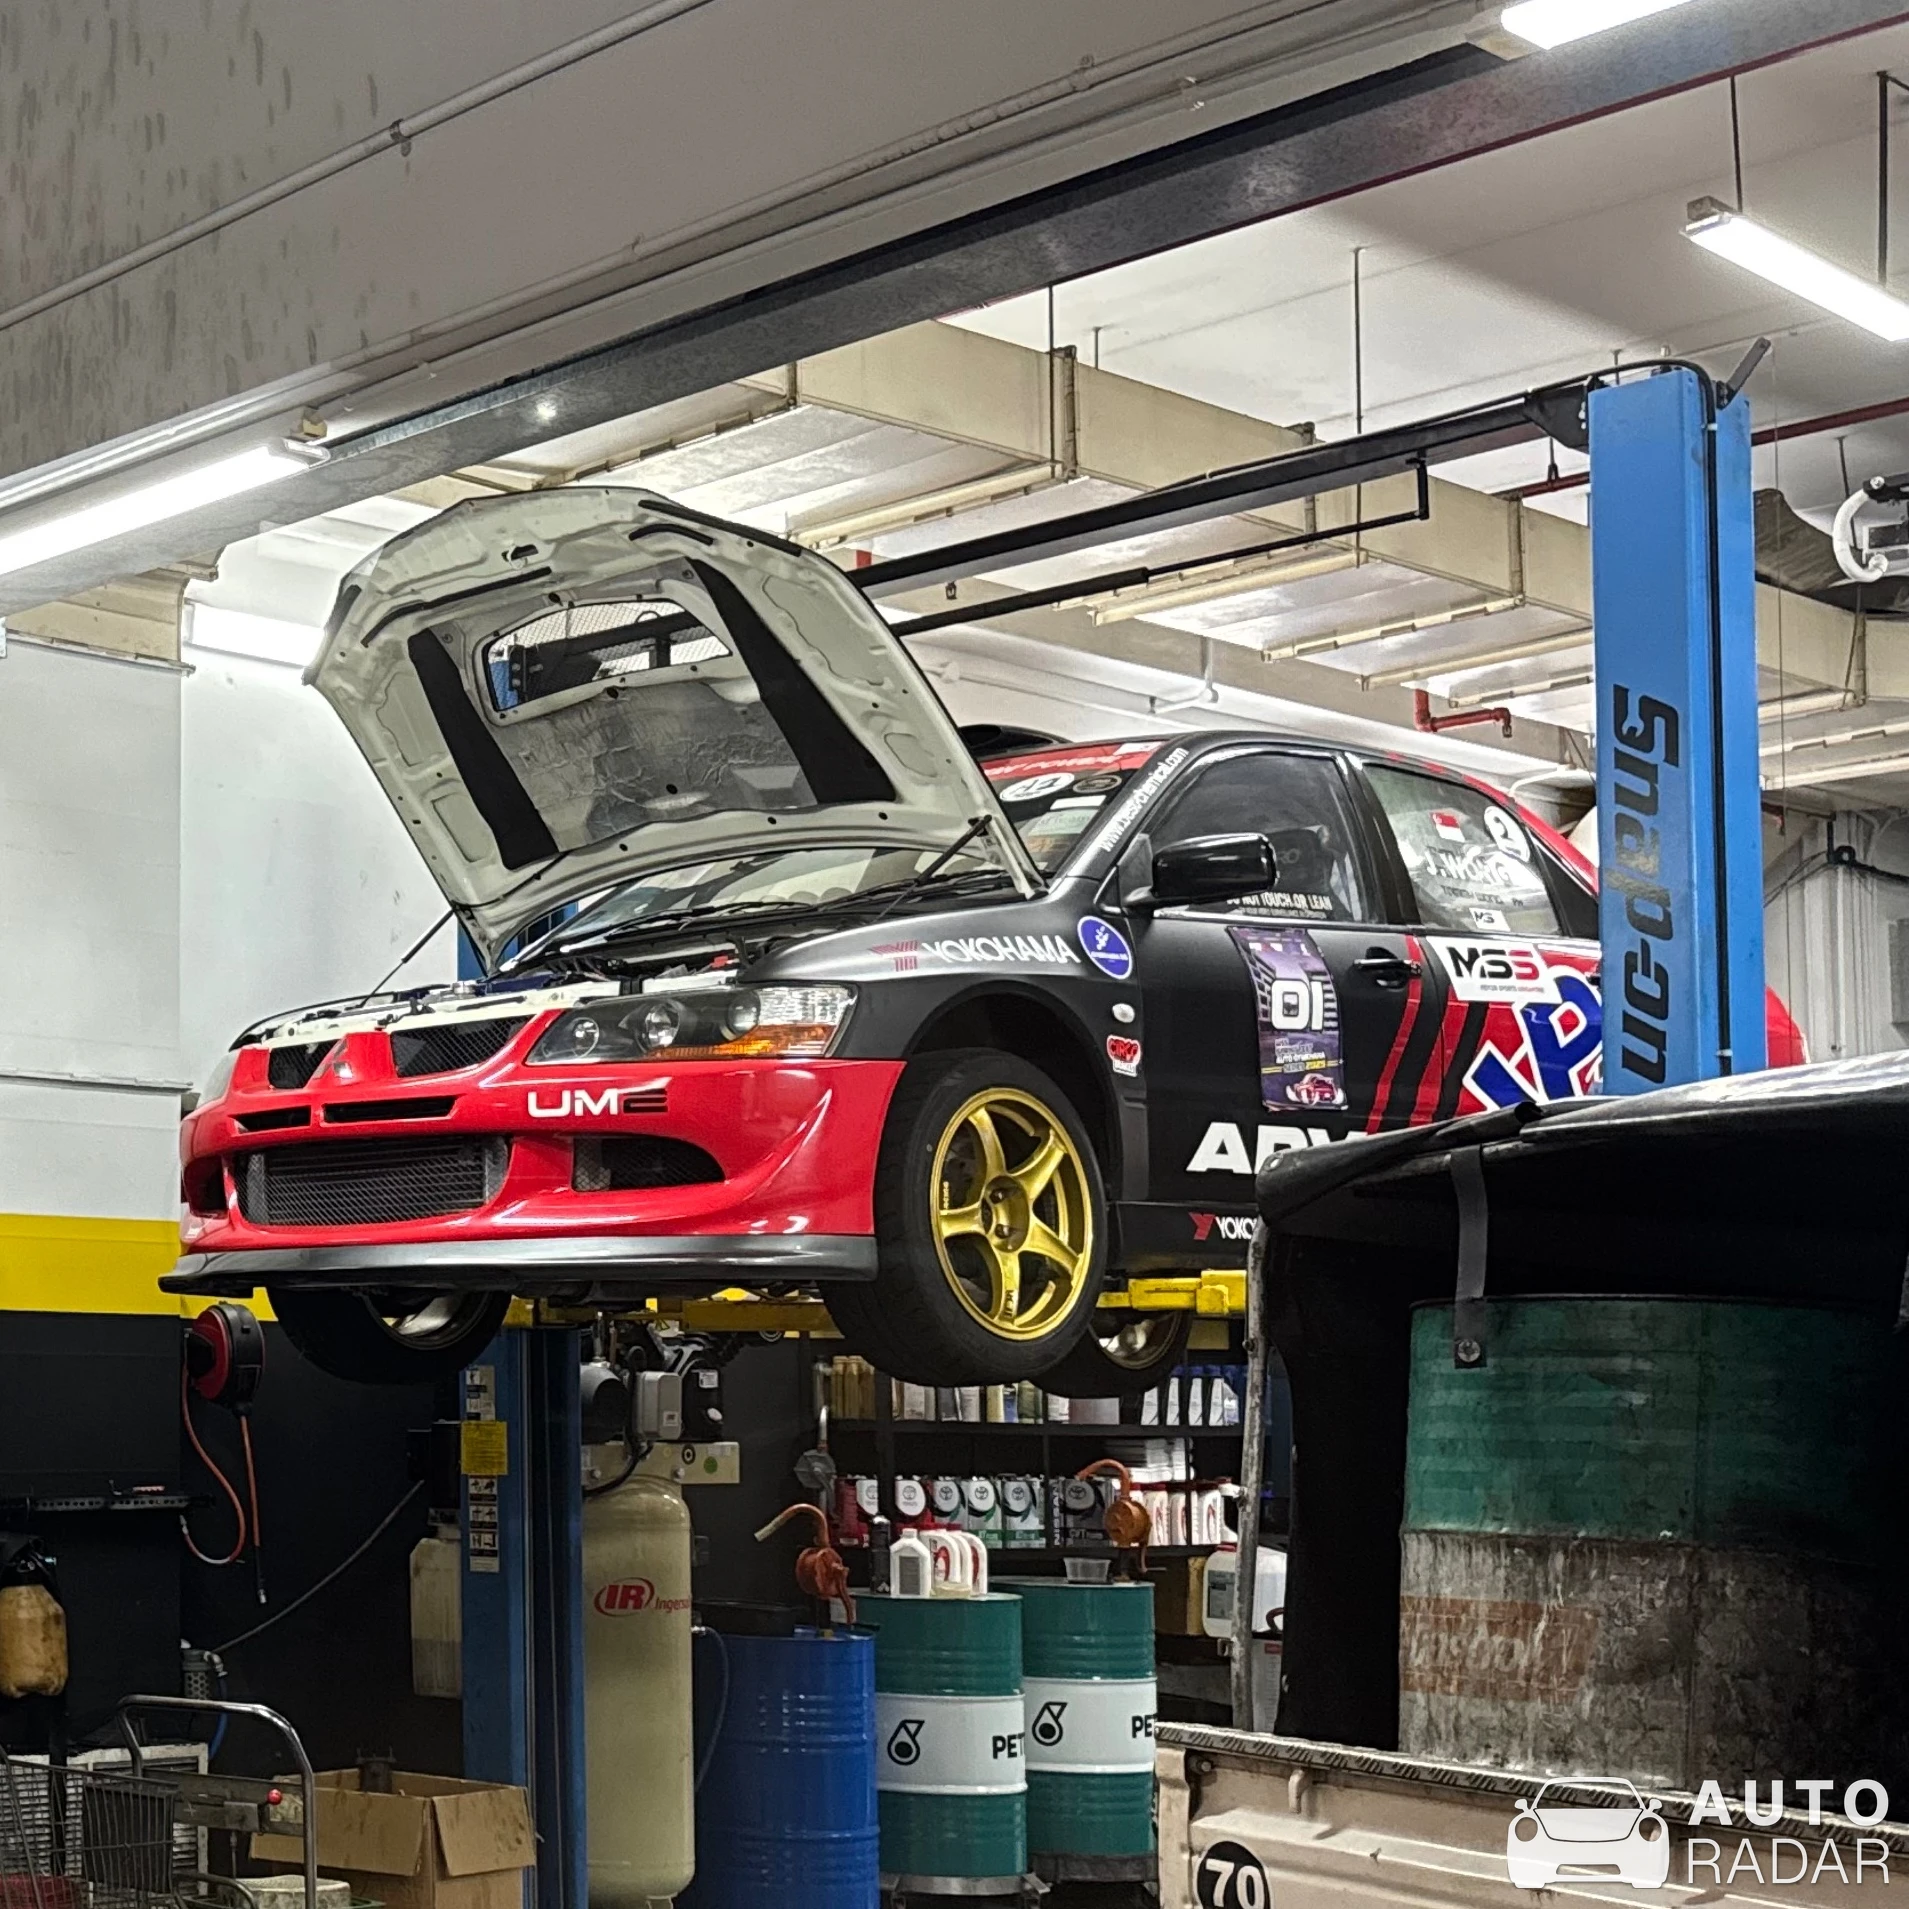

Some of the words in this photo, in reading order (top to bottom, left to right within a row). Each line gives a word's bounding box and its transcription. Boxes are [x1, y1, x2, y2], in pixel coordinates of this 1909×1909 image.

[1607, 684, 1679, 1084] Snap-on
[1260, 891, 1292, 908] TOUCH
[1307, 894, 1333, 911] LEAN
[921, 935, 1081, 964] YOKOHAMA
[1446, 946, 1540, 981] MSS
[604, 1584, 646, 1610] IR
[1205, 1858, 1265, 1909] 70
